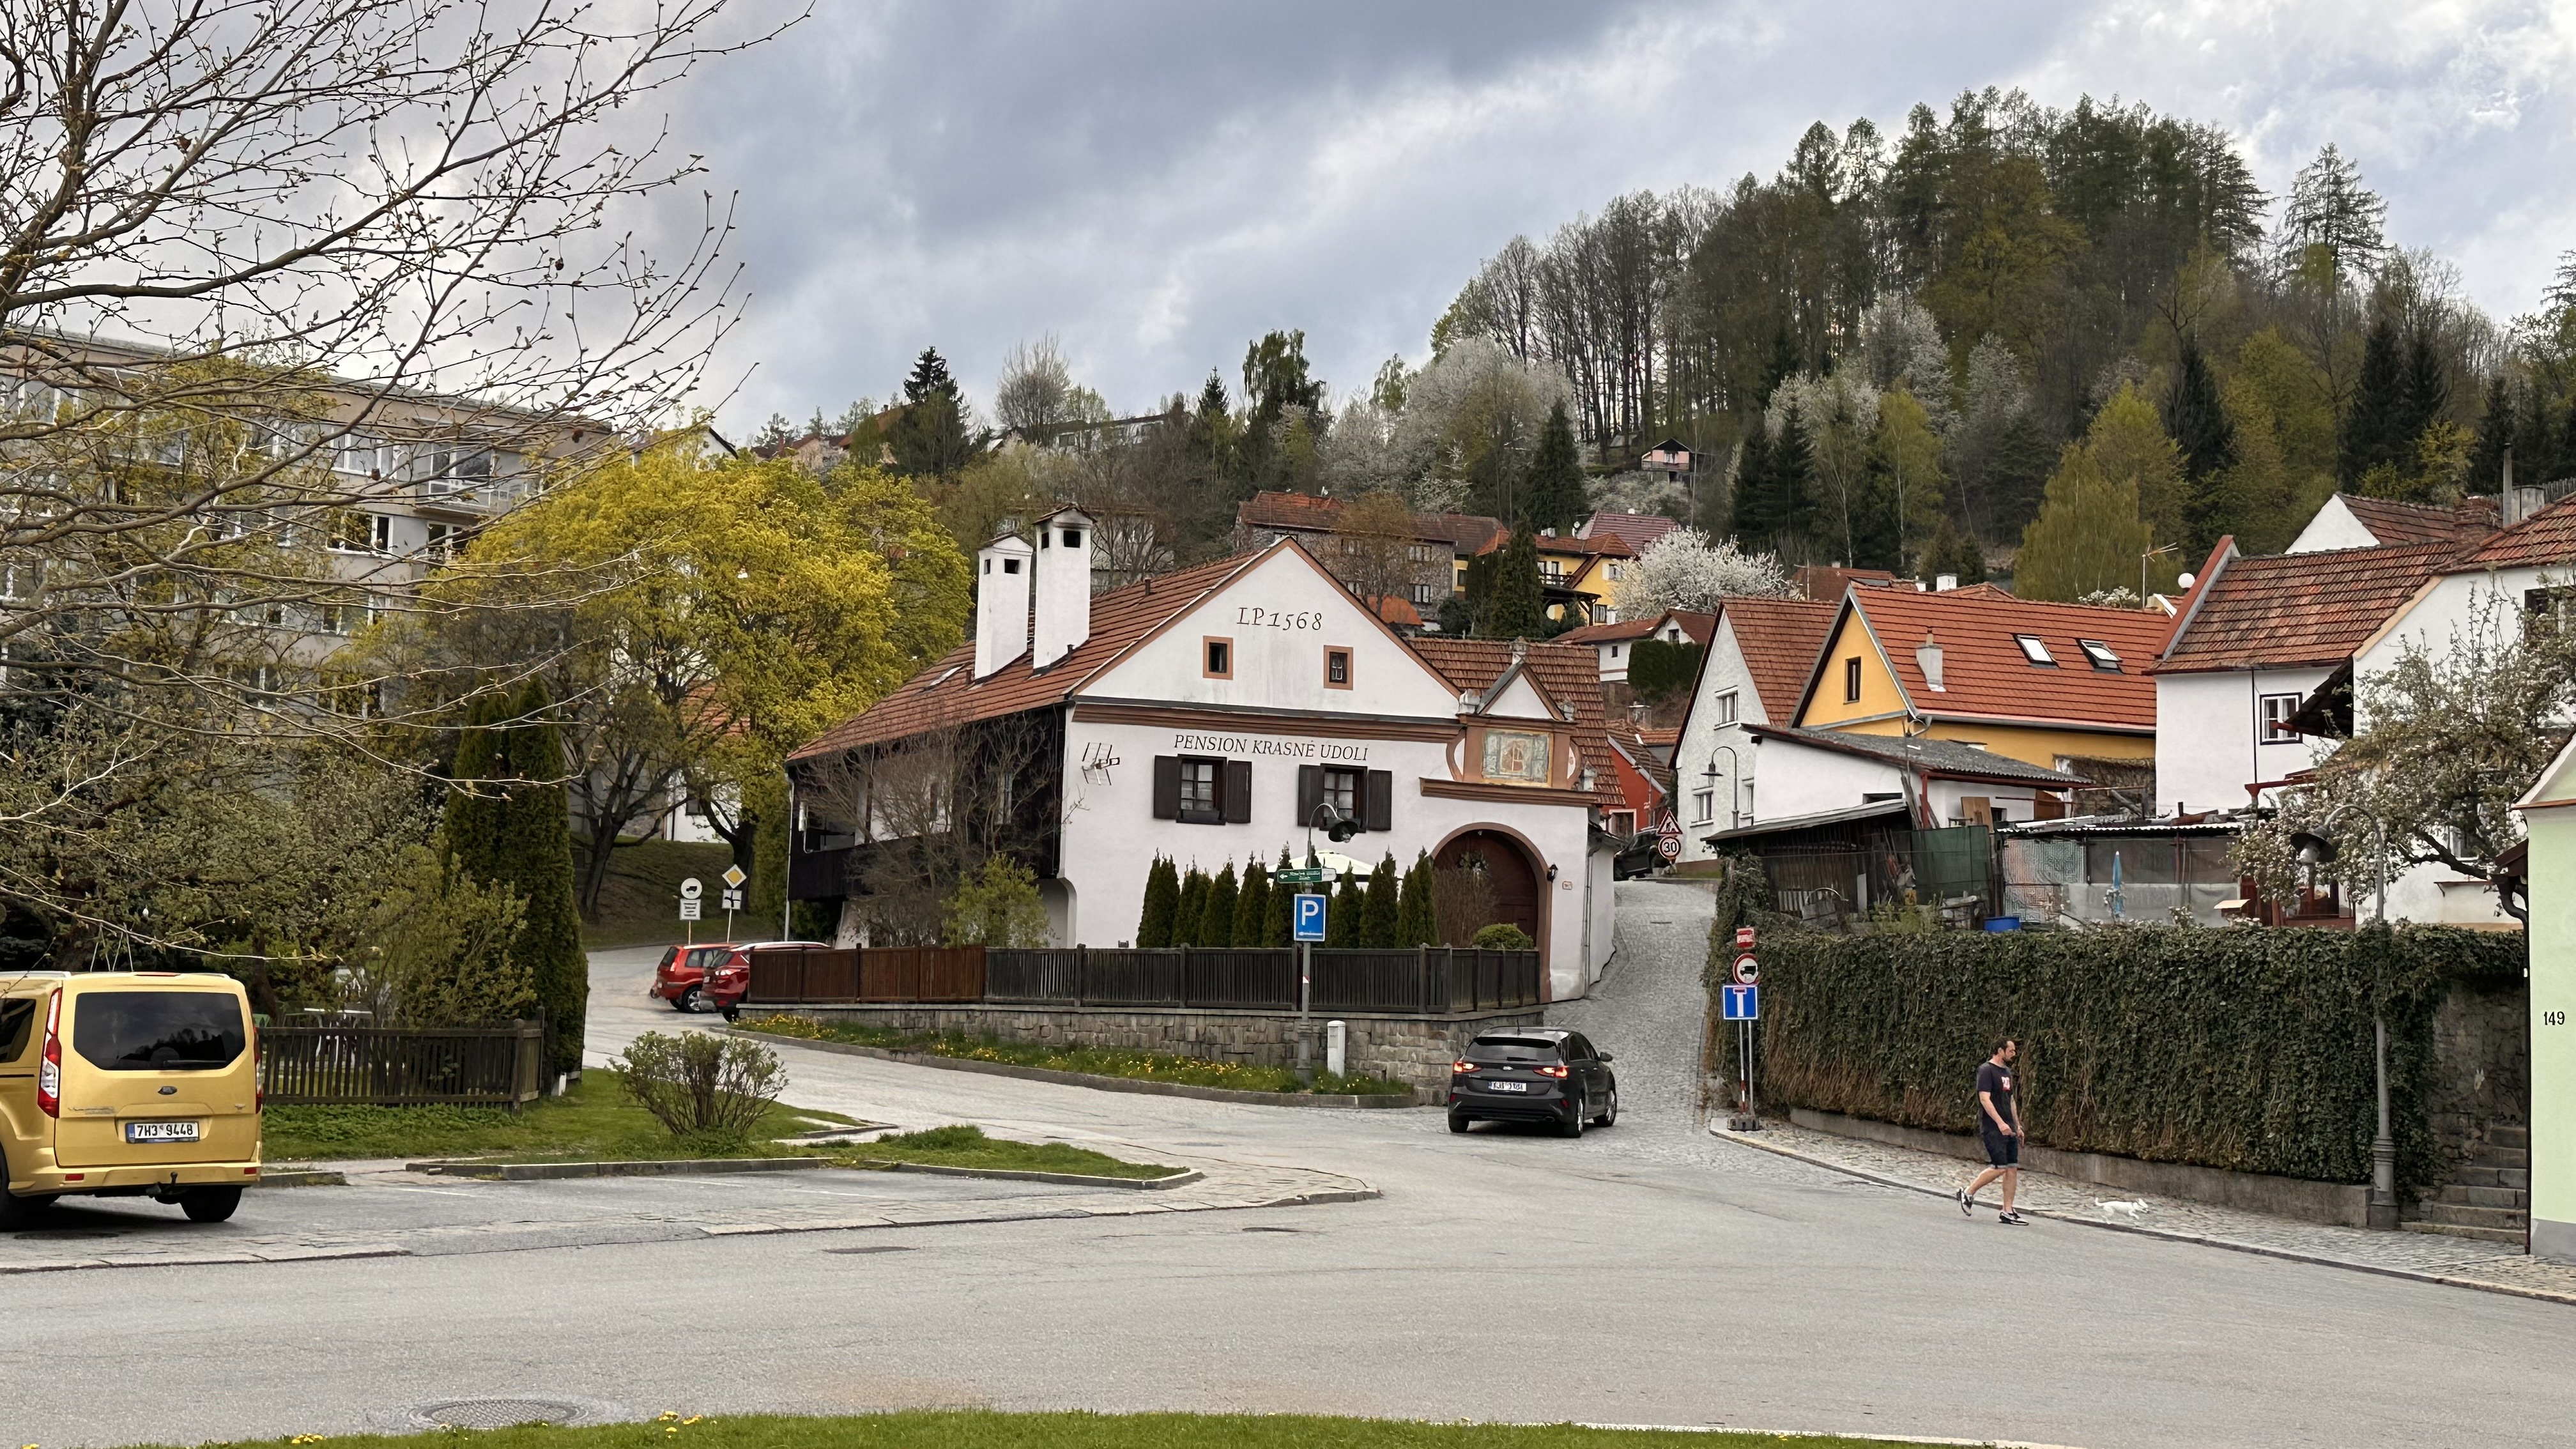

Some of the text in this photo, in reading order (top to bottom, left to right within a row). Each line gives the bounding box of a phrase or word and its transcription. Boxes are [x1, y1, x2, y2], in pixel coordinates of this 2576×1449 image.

[1267, 611, 1322, 631] 1568
[1174, 734, 1248, 753] PENSION
[1663, 841, 1677, 853] 30
[1301, 900, 1319, 926] P
[2543, 1011, 2565, 1025] 149
[137, 1124, 158, 1137] 7H3
[165, 1124, 194, 1136] 9448
